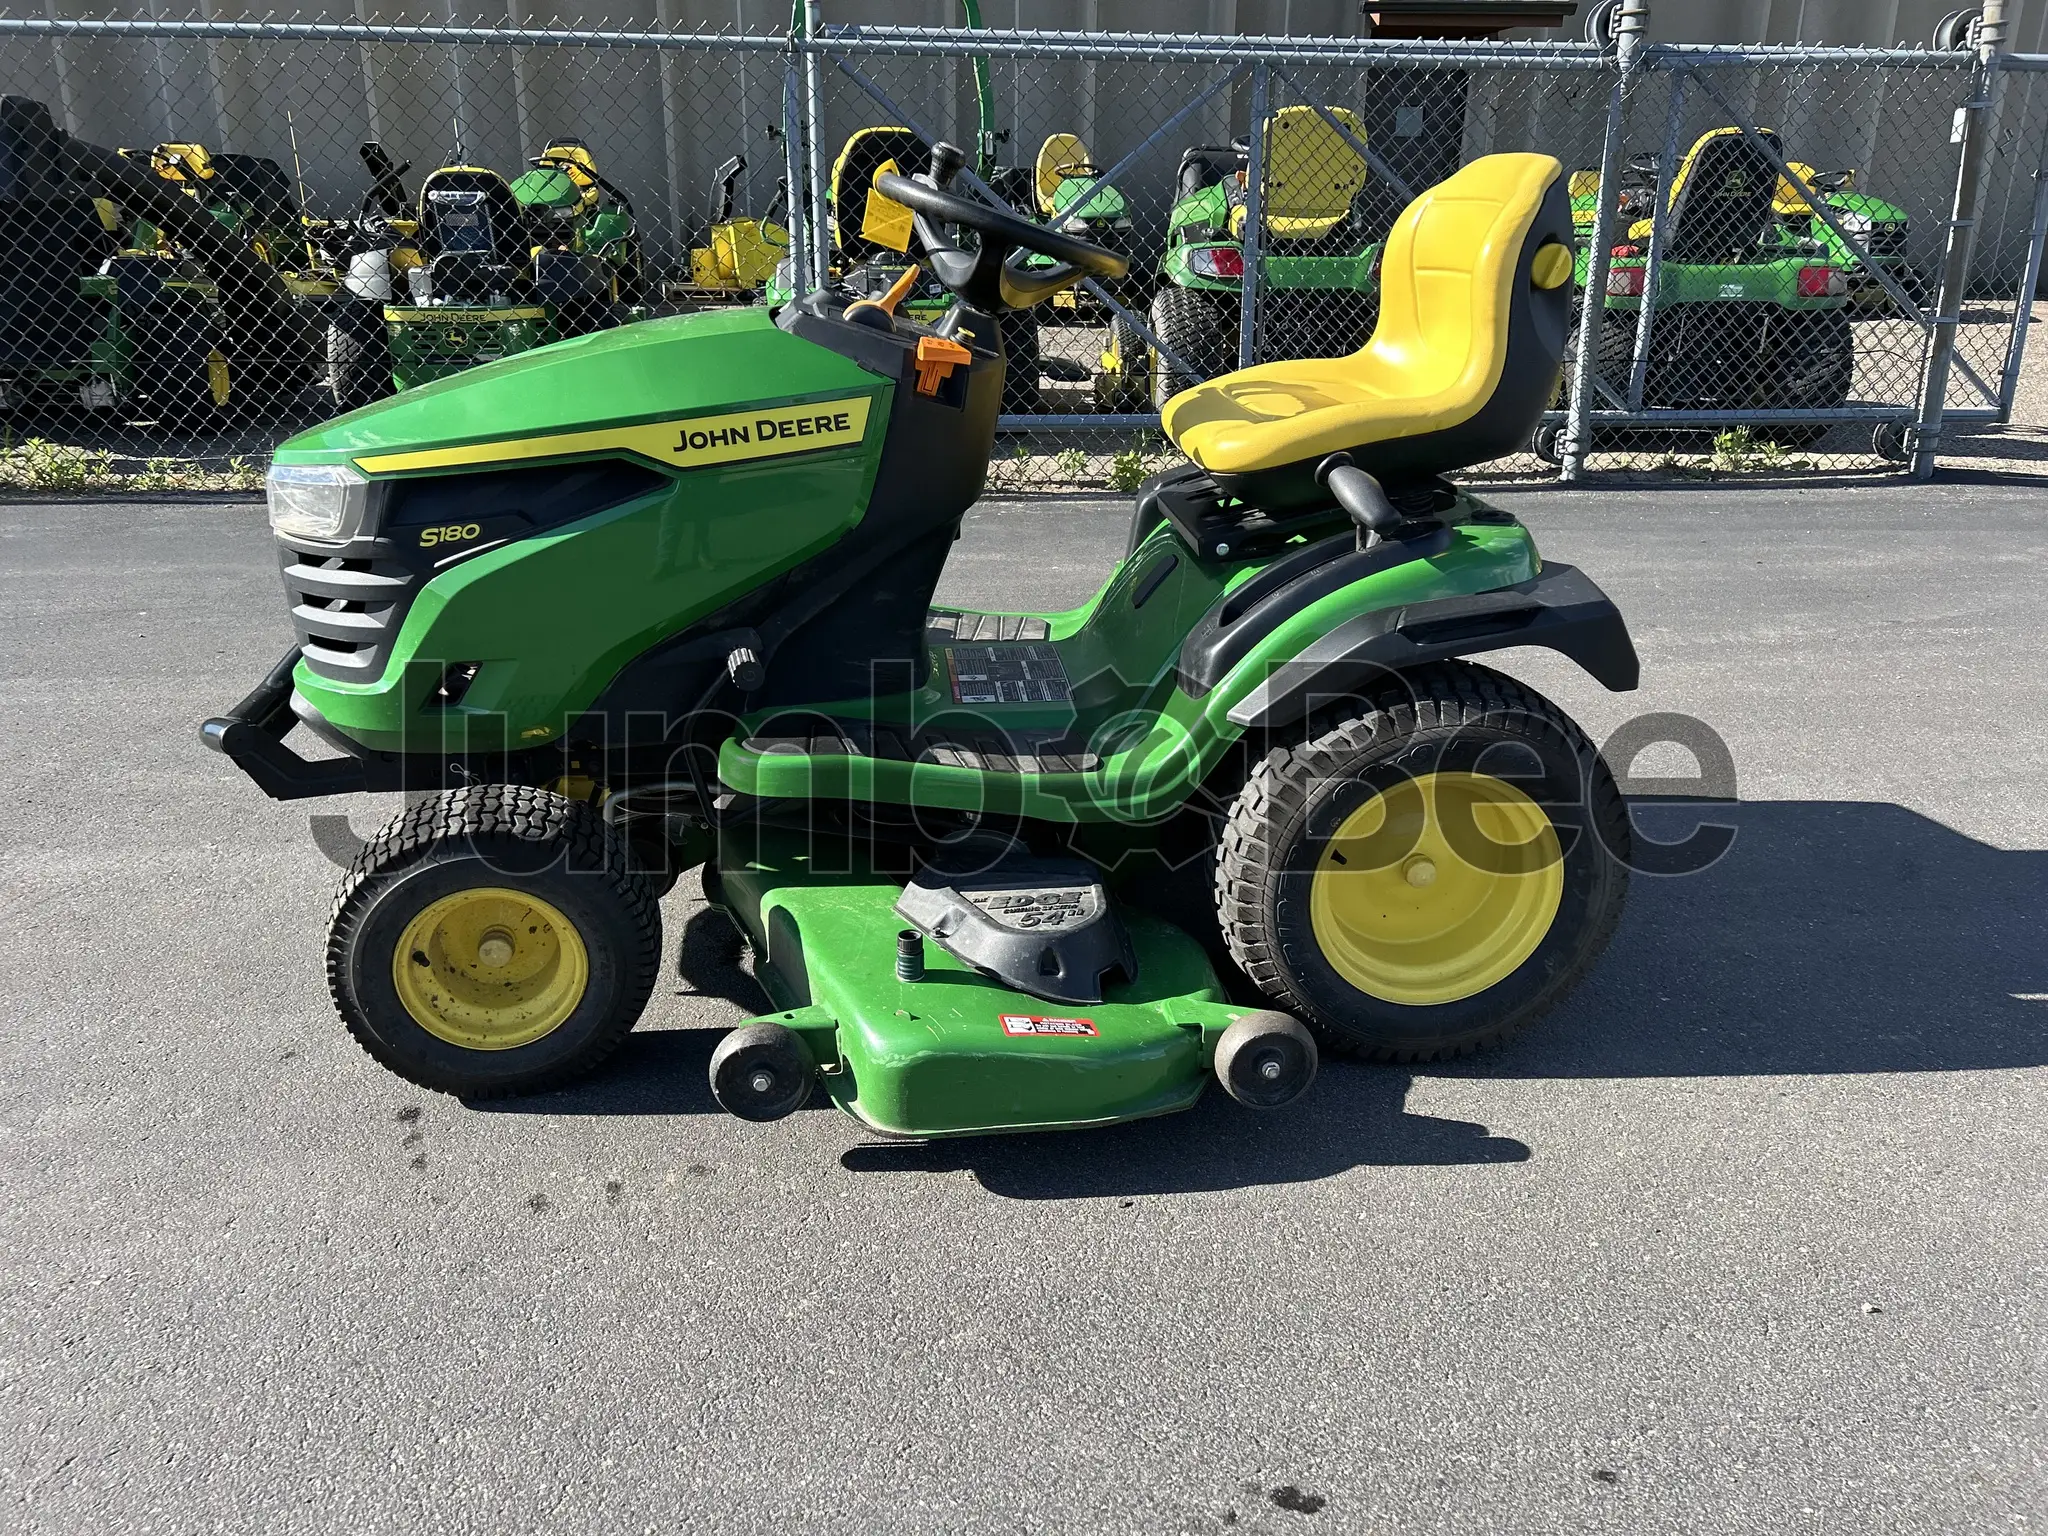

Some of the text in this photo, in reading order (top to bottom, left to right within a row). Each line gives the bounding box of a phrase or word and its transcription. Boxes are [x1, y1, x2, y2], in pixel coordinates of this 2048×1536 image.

[421, 313, 487, 322] JOHN DEERE
[673, 412, 851, 452] JOHN DEERE
[420, 523, 481, 547] S180
[987, 892, 1083, 910] EDGE
[1018, 908, 1085, 928] 54"
